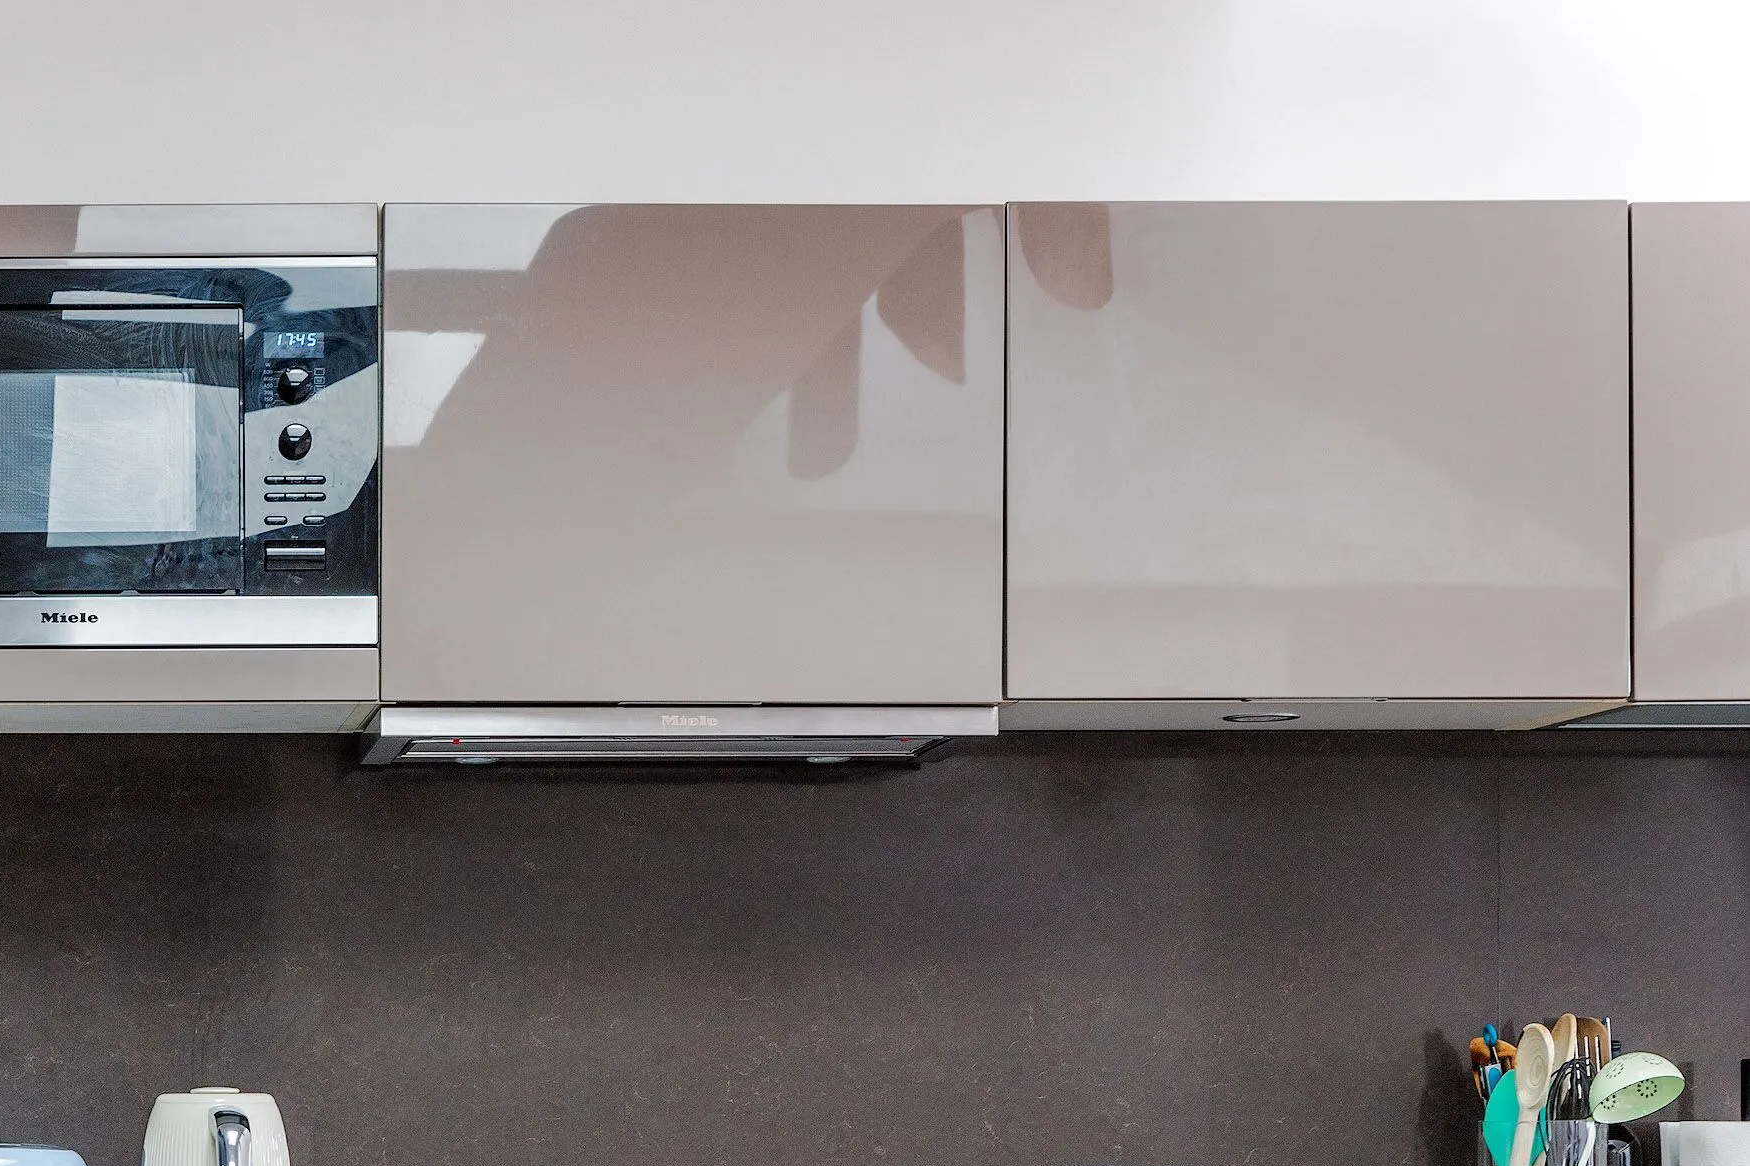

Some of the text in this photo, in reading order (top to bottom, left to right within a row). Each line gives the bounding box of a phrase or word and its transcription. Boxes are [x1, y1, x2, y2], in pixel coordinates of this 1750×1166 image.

[277, 332, 317, 347] 17:45
[40, 612, 99, 623] Miele
[661, 715, 719, 726] Miele
